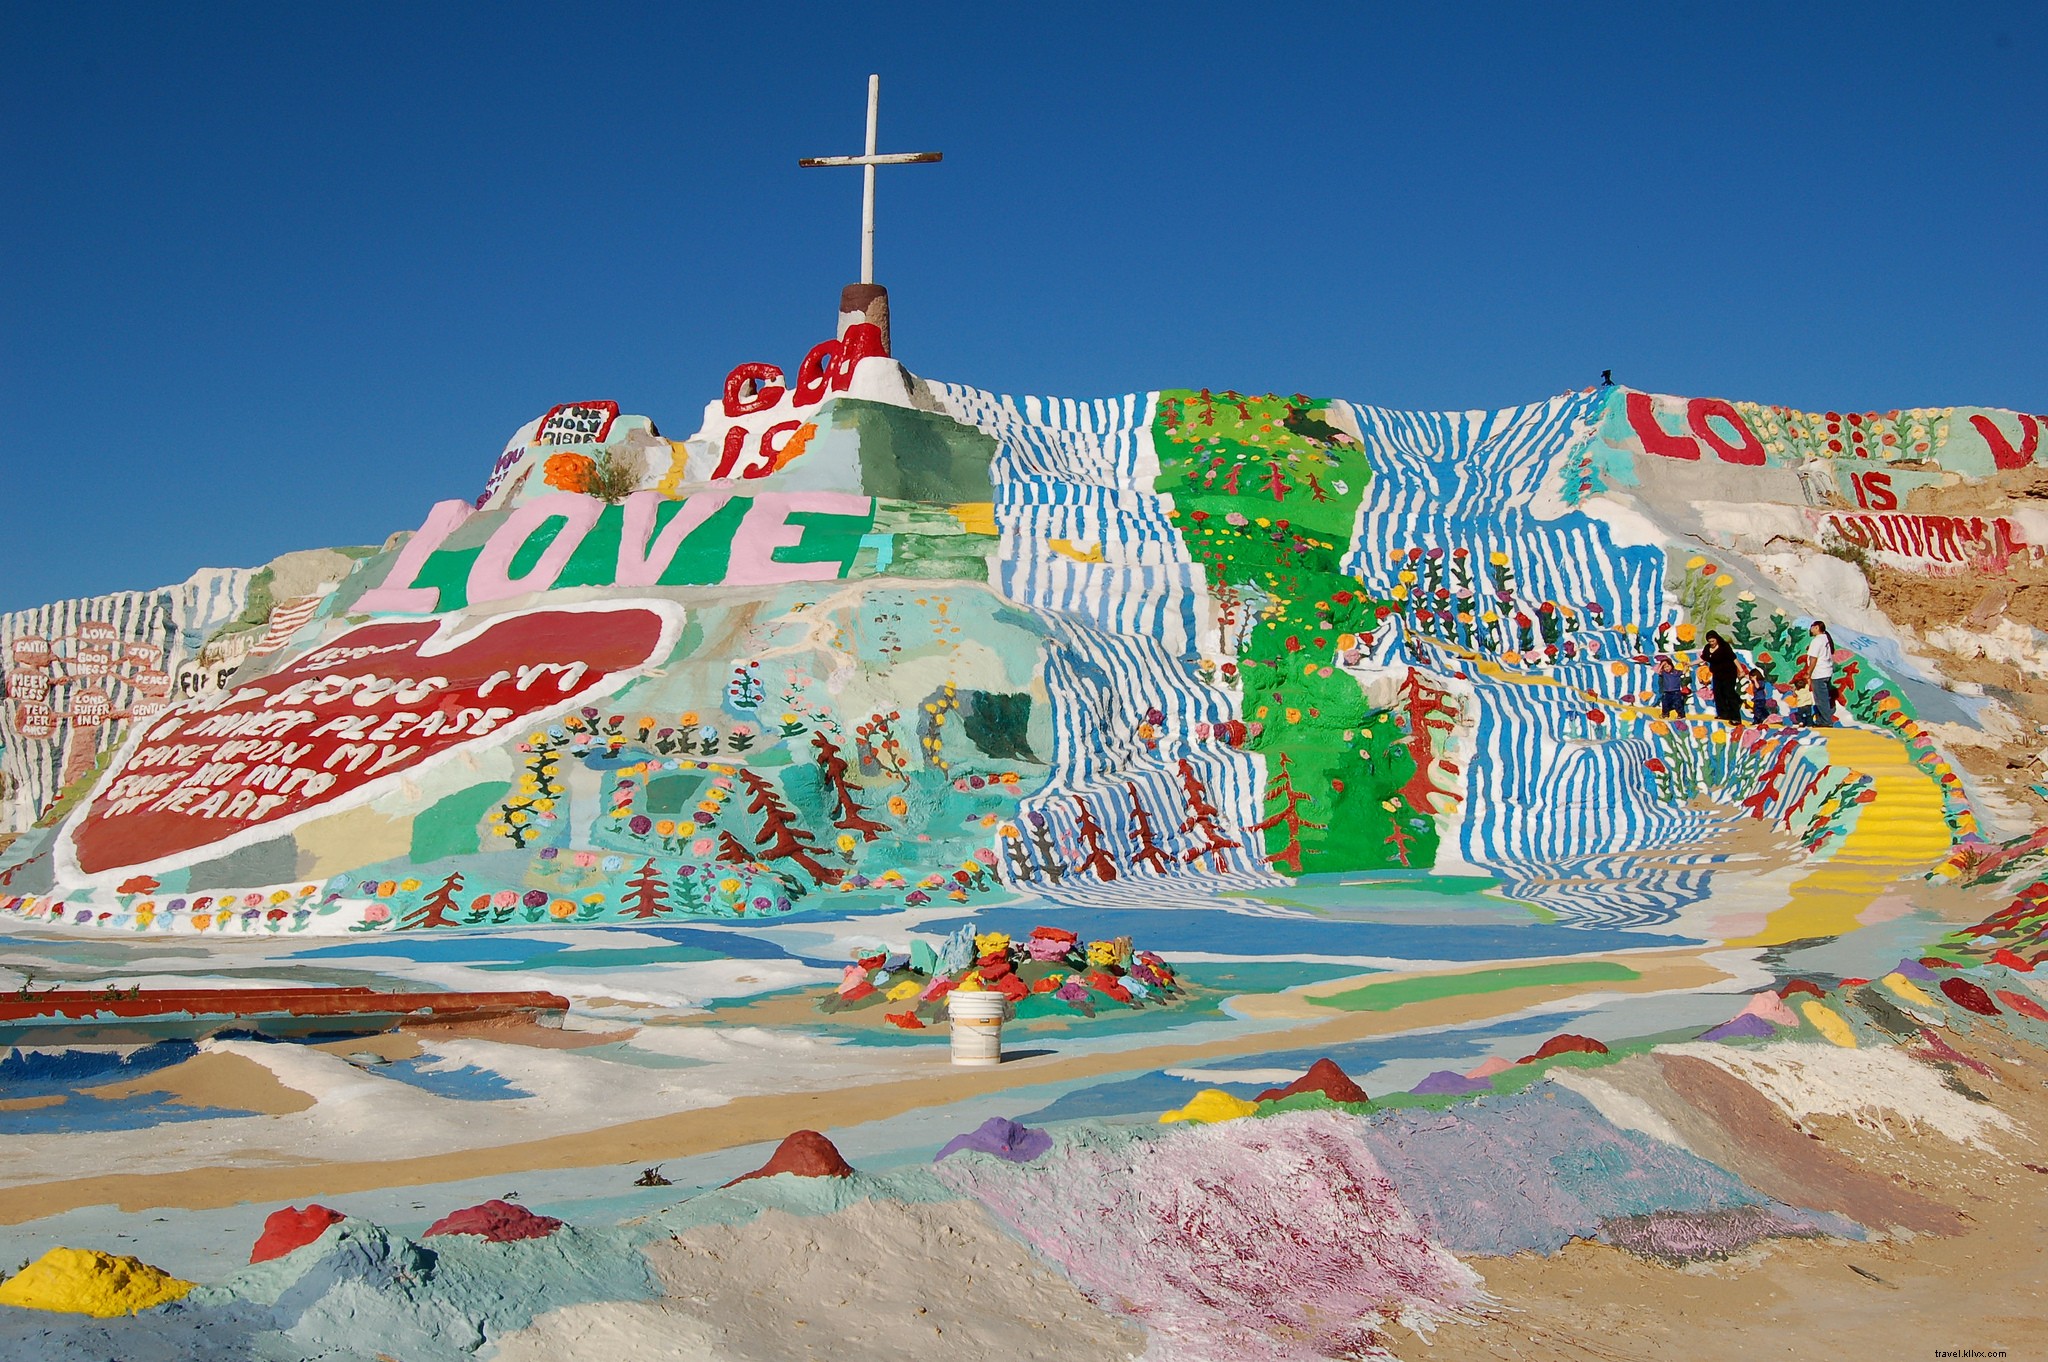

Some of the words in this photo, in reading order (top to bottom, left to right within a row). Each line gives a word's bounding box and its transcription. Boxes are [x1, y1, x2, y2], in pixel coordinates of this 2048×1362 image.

[721, 322, 889, 418] GOD
[557, 405, 602, 420] THE
[547, 417, 602, 433] HOLY
[711, 420, 803, 481] IS
[1850, 471, 1897, 511] IS
[348, 491, 872, 614] LOVE
[81, 627, 116, 641] LOVE
[16, 641, 49, 653] FAITH
[1850, 635, 1879, 651] OUR
[77, 652, 109, 664] GOOD
[128, 648, 160, 662] JOY
[77, 664, 109, 675] NESS
[11, 673, 49, 689] MEEK
[135, 674, 170, 685] PEACE
[477, 660, 589, 698] I'M
[10, 687, 46, 701] NESS
[25, 704, 49, 715] TEM
[73, 704, 111, 716] SUFFER
[26, 715, 50, 726] PER
[77, 715, 102, 726] ING
[309, 707, 514, 740] PLEASE
[22, 726, 48, 735] ANCE
[127, 743, 218, 771] COME
[211, 739, 315, 764] UPON
[322, 743, 422, 775] MY
[241, 763, 338, 797] INTO
[148, 787, 288, 820] HEART
